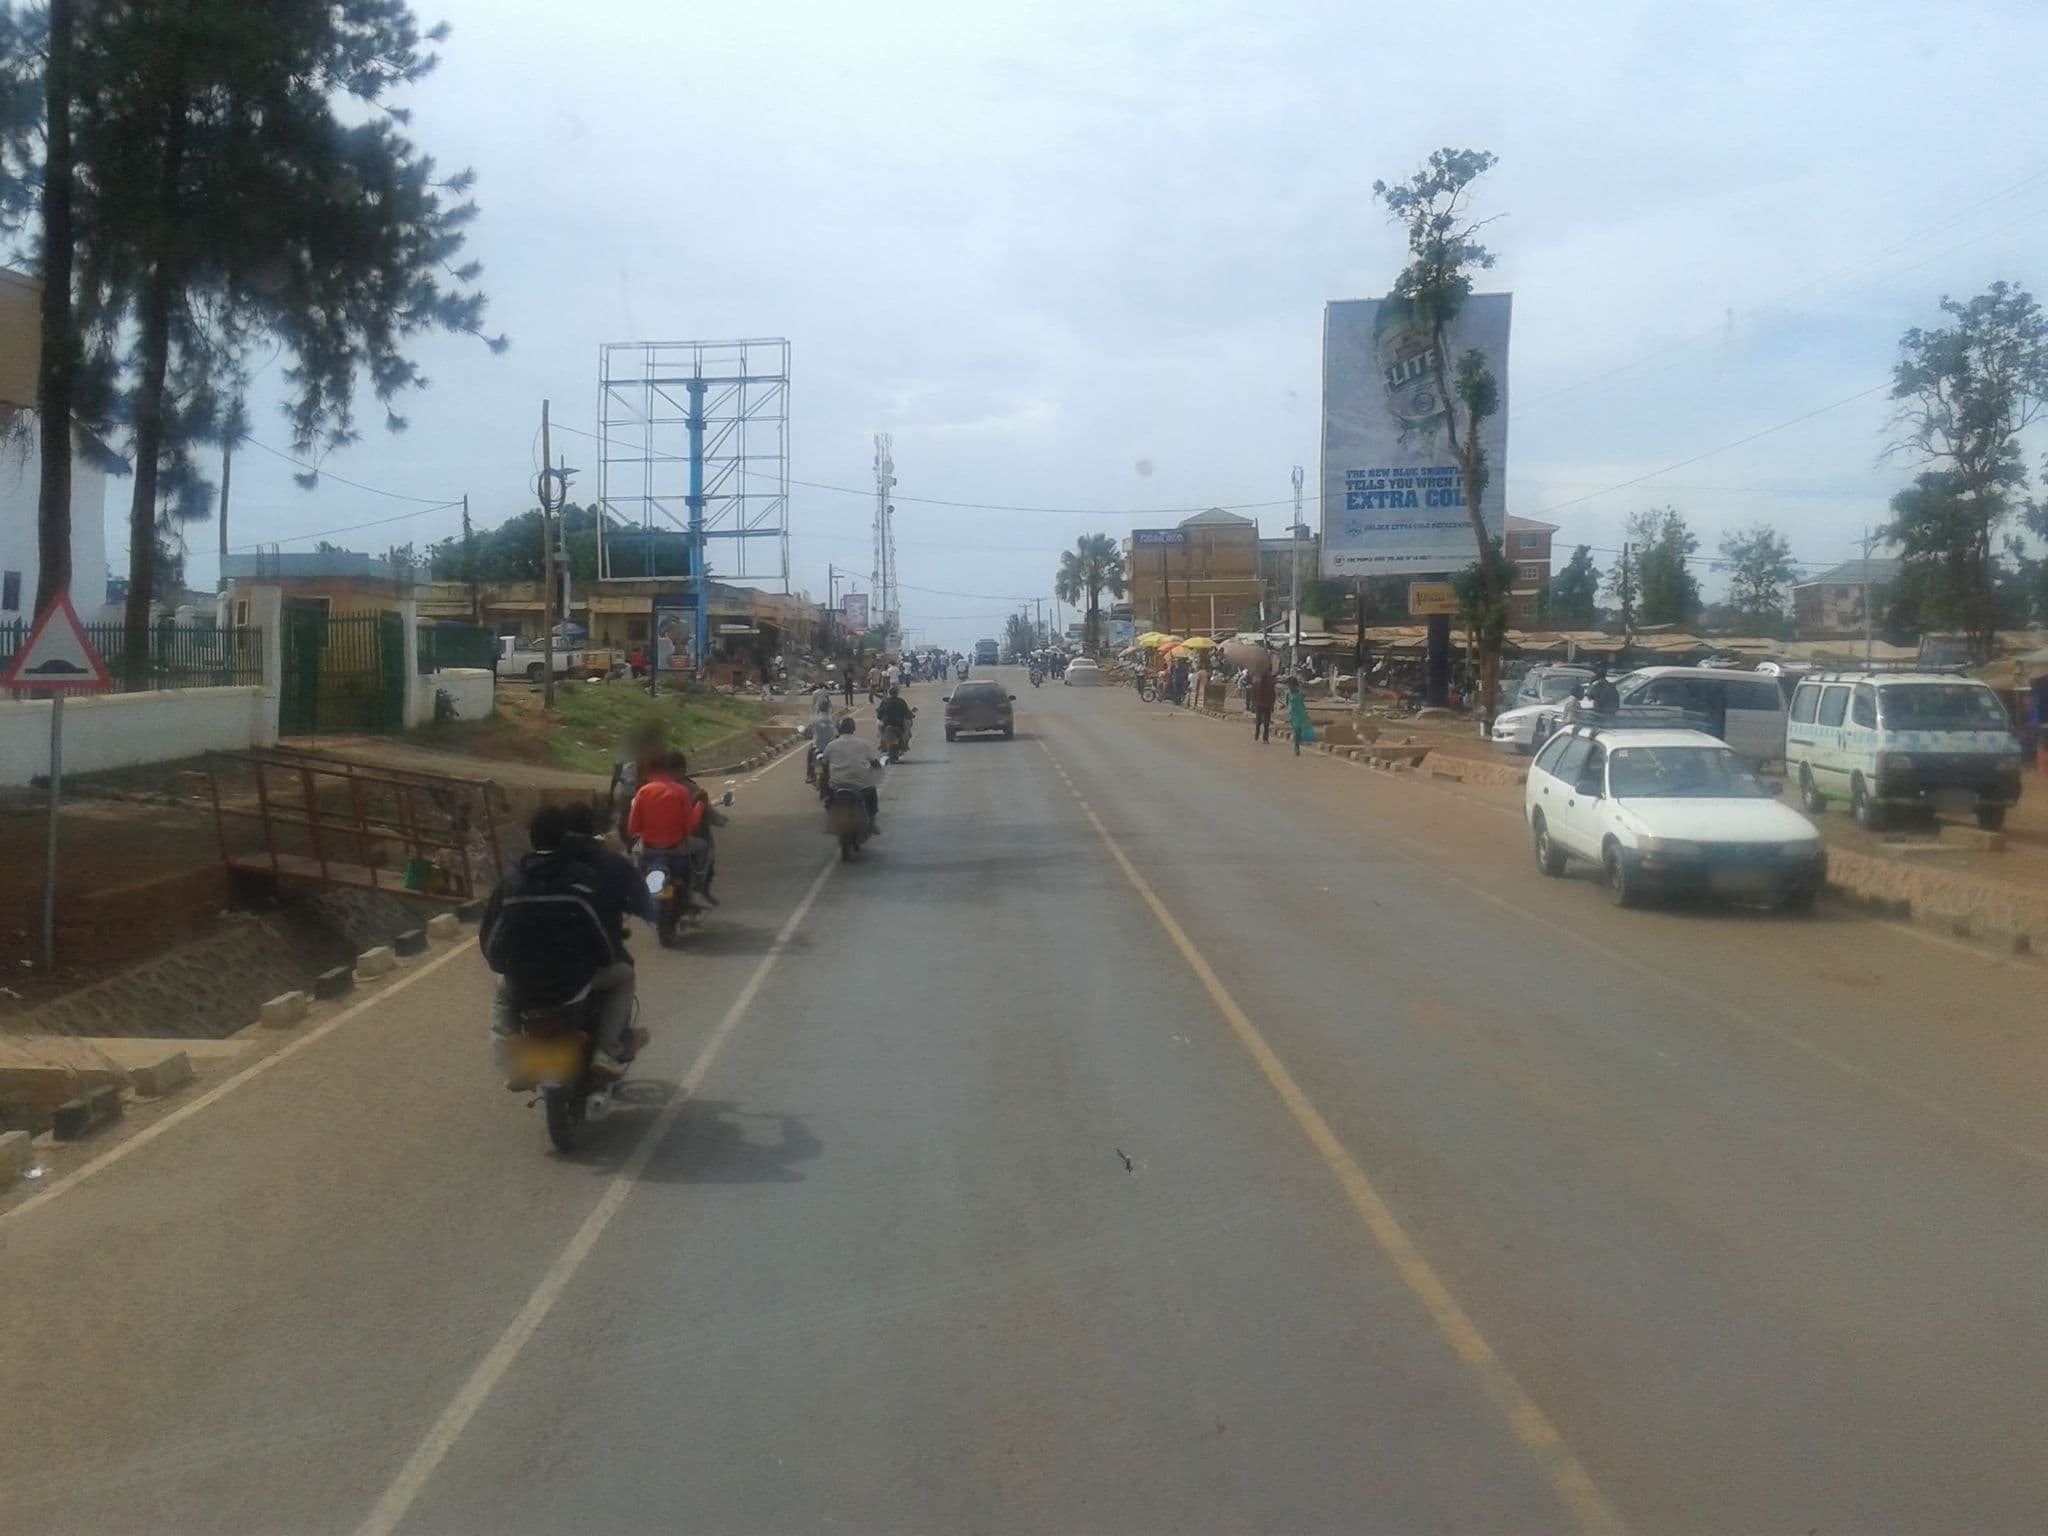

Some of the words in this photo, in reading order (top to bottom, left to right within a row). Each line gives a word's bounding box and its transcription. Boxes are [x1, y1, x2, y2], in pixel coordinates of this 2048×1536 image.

[1346, 470, 1366, 478] THE
[1368, 469, 1391, 477] NEW
[1393, 468, 1419, 476] BLUE
[1345, 479, 1385, 490] TELLS
[1389, 478, 1413, 489] YOU
[1416, 477, 1452, 488] WHEN
[1346, 490, 1419, 510] EXTRA
